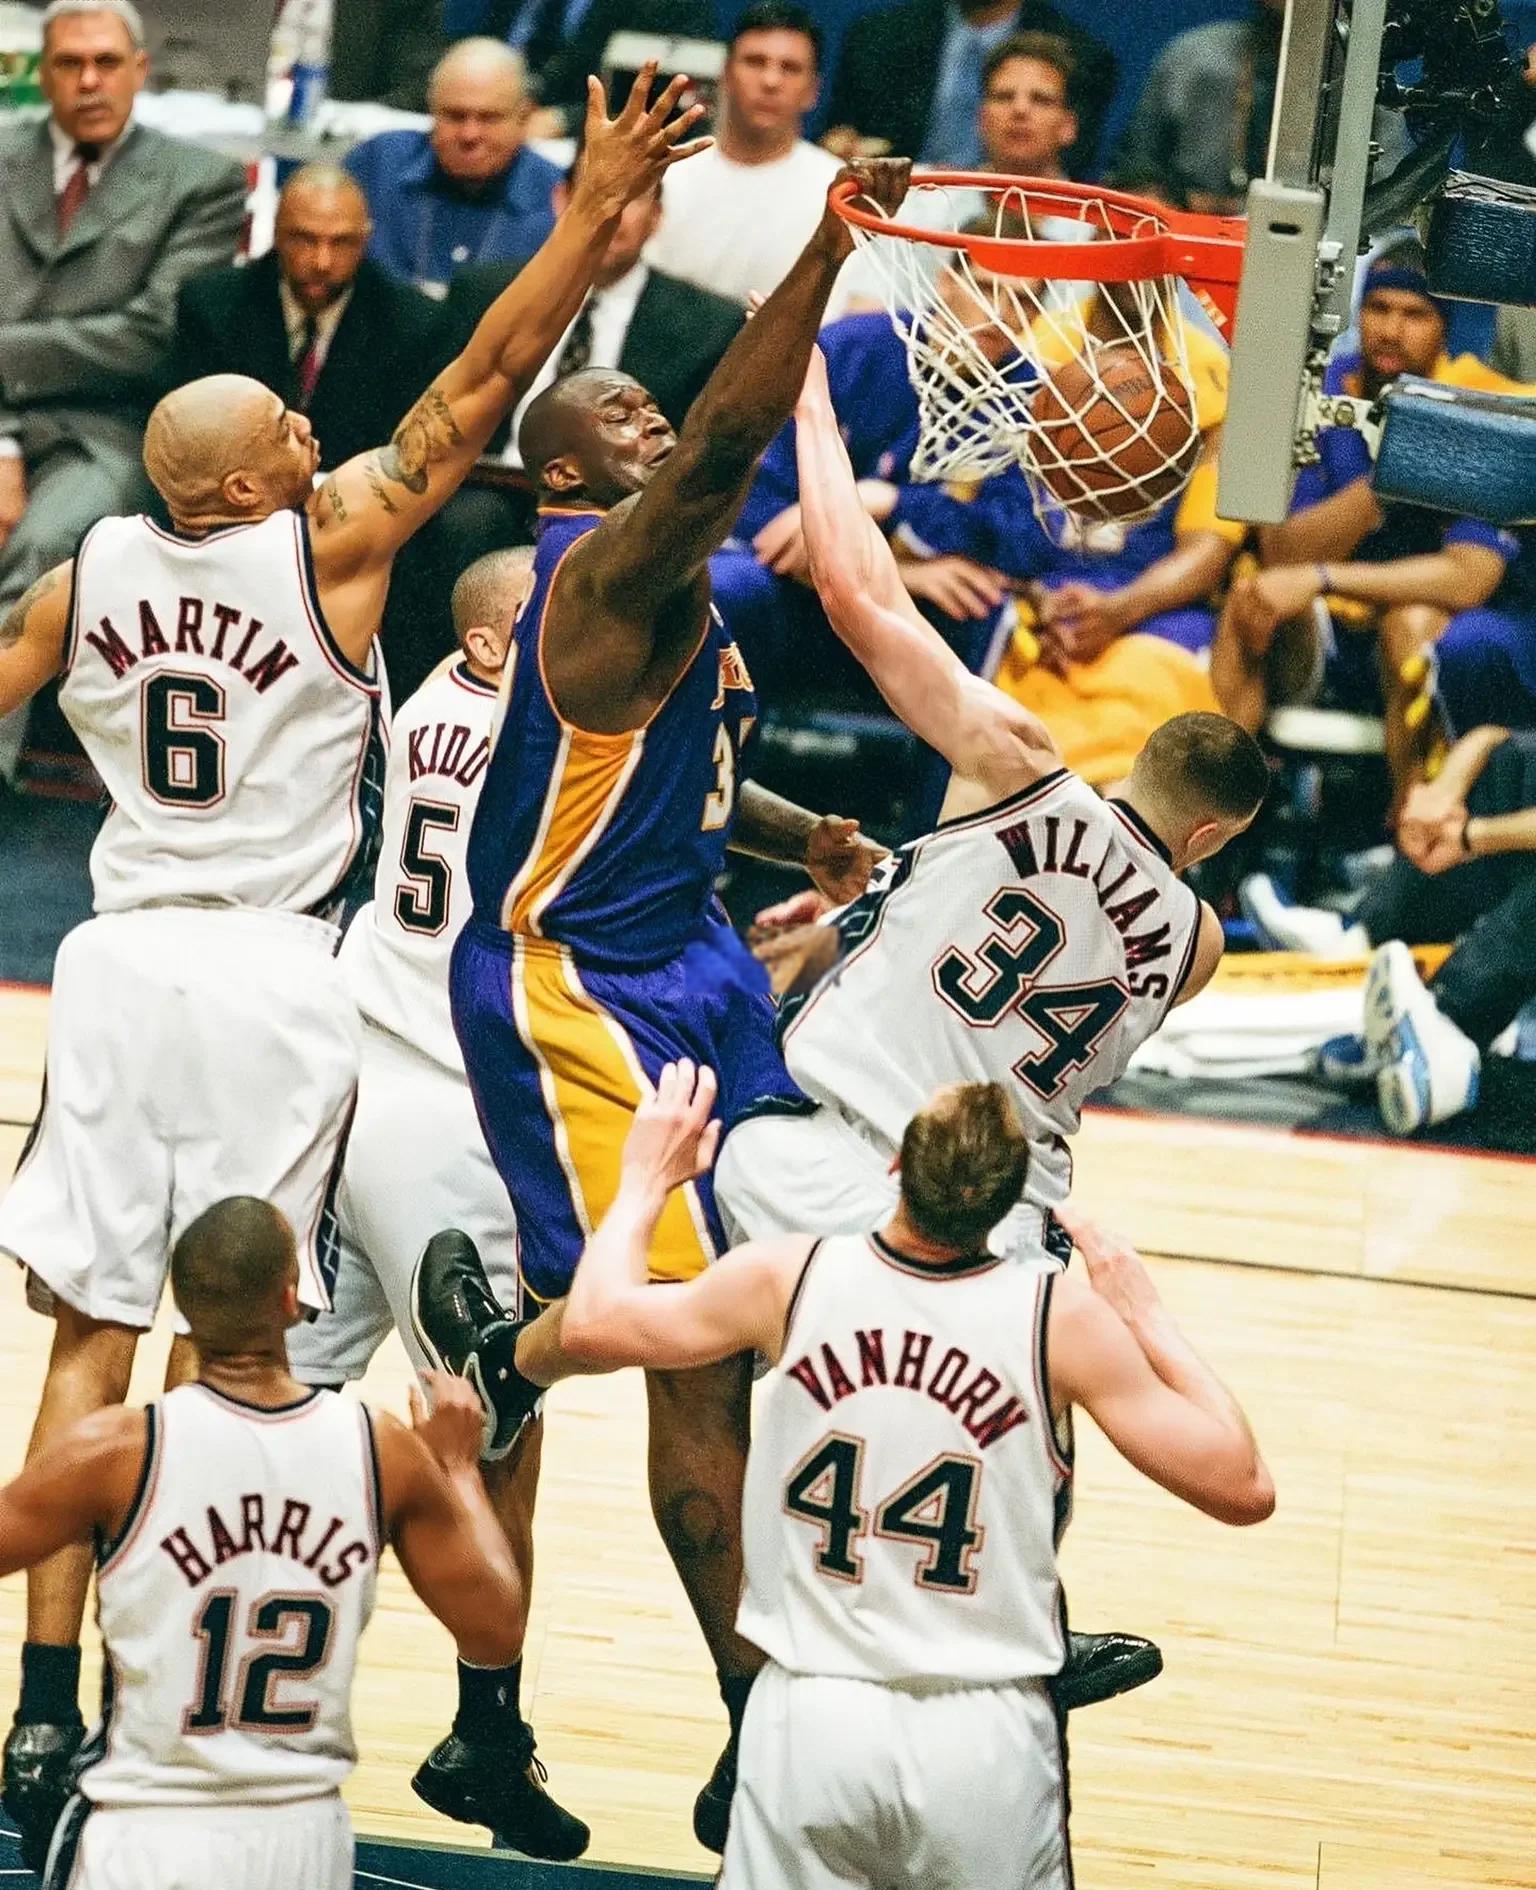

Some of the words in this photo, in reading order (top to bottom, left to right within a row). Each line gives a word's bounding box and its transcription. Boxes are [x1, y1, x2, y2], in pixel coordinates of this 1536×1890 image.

[84, 596, 300, 694] MARTIN
[140, 667, 226, 809] 6
[408, 722, 490, 787] KIDD
[702, 716, 756, 832] 3
[393, 796, 461, 937] 5
[930, 886, 1133, 1101] 34
[785, 1329, 1030, 1450] VANHORN
[160, 1493, 369, 1588] HARRIS
[783, 1430, 984, 1595] 44
[181, 1586, 339, 1736] 12
